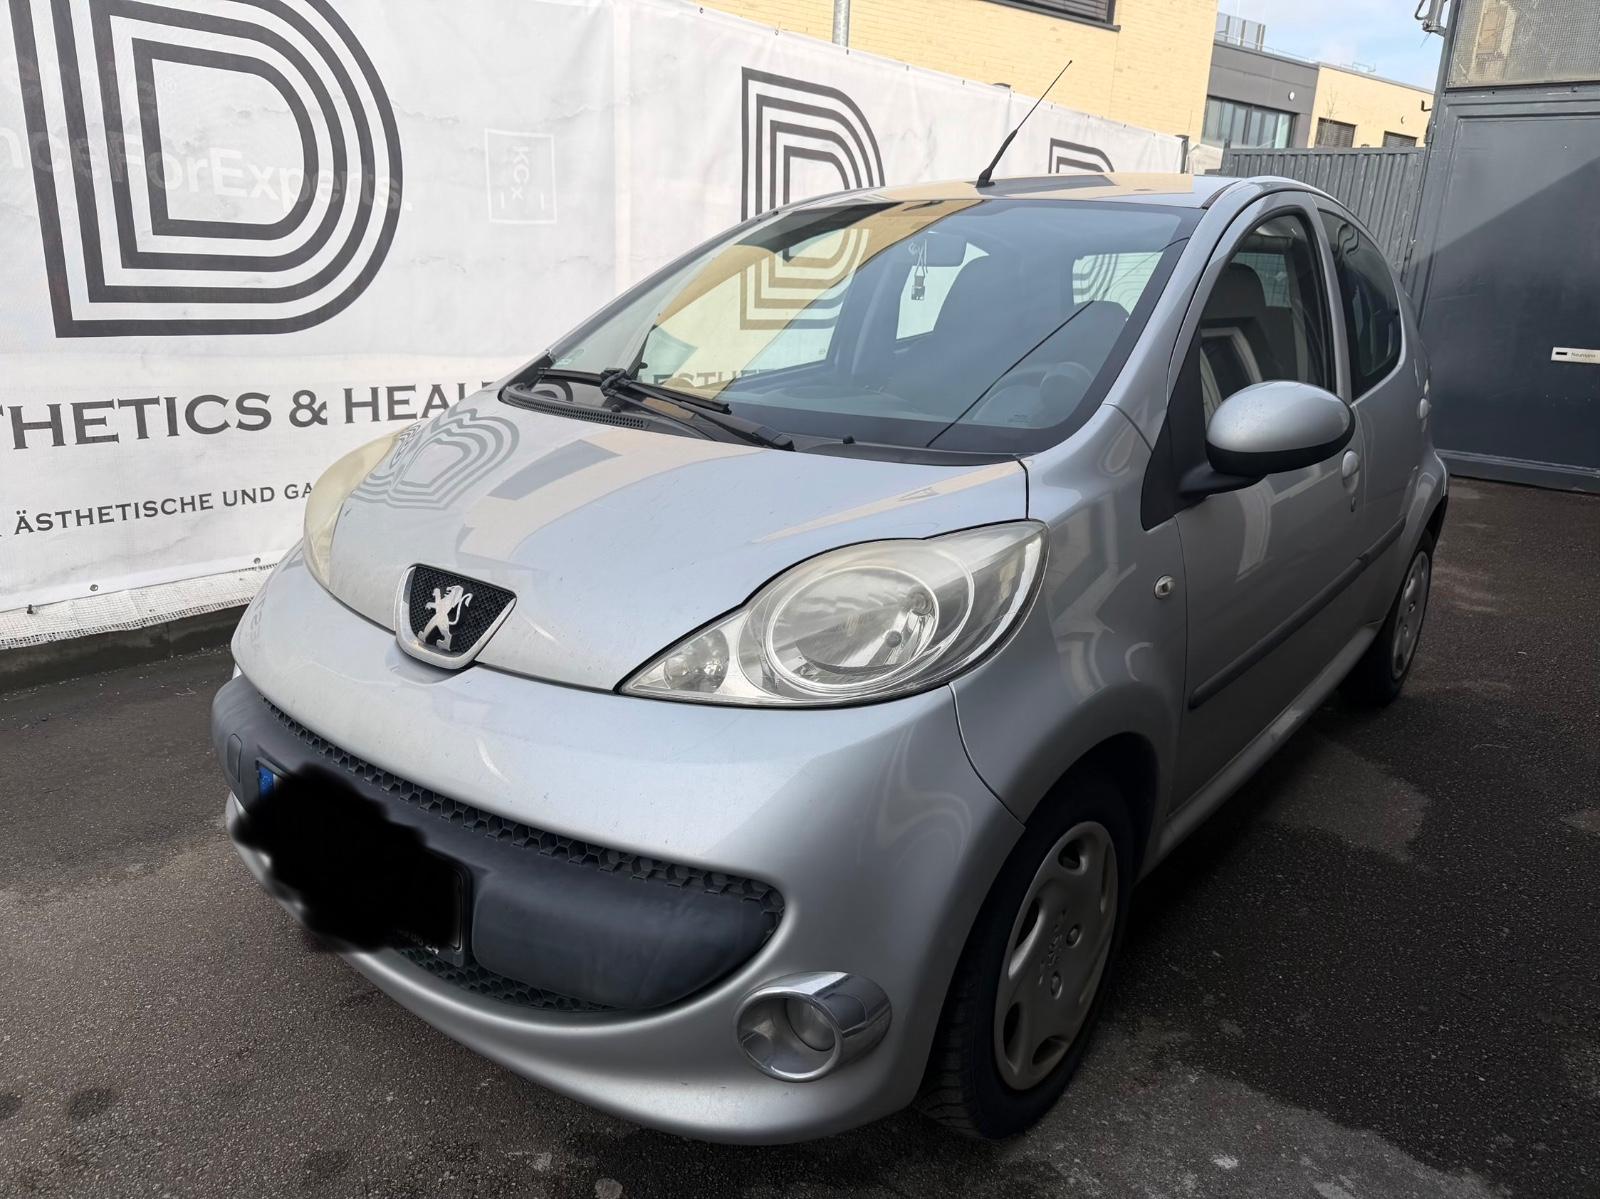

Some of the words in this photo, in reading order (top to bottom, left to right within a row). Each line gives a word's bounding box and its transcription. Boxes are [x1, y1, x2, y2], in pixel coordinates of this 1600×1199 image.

[288, 389, 328, 428] &
[14, 492, 214, 536] ÄSTHETISCHE
[222, 486, 275, 507] UND
